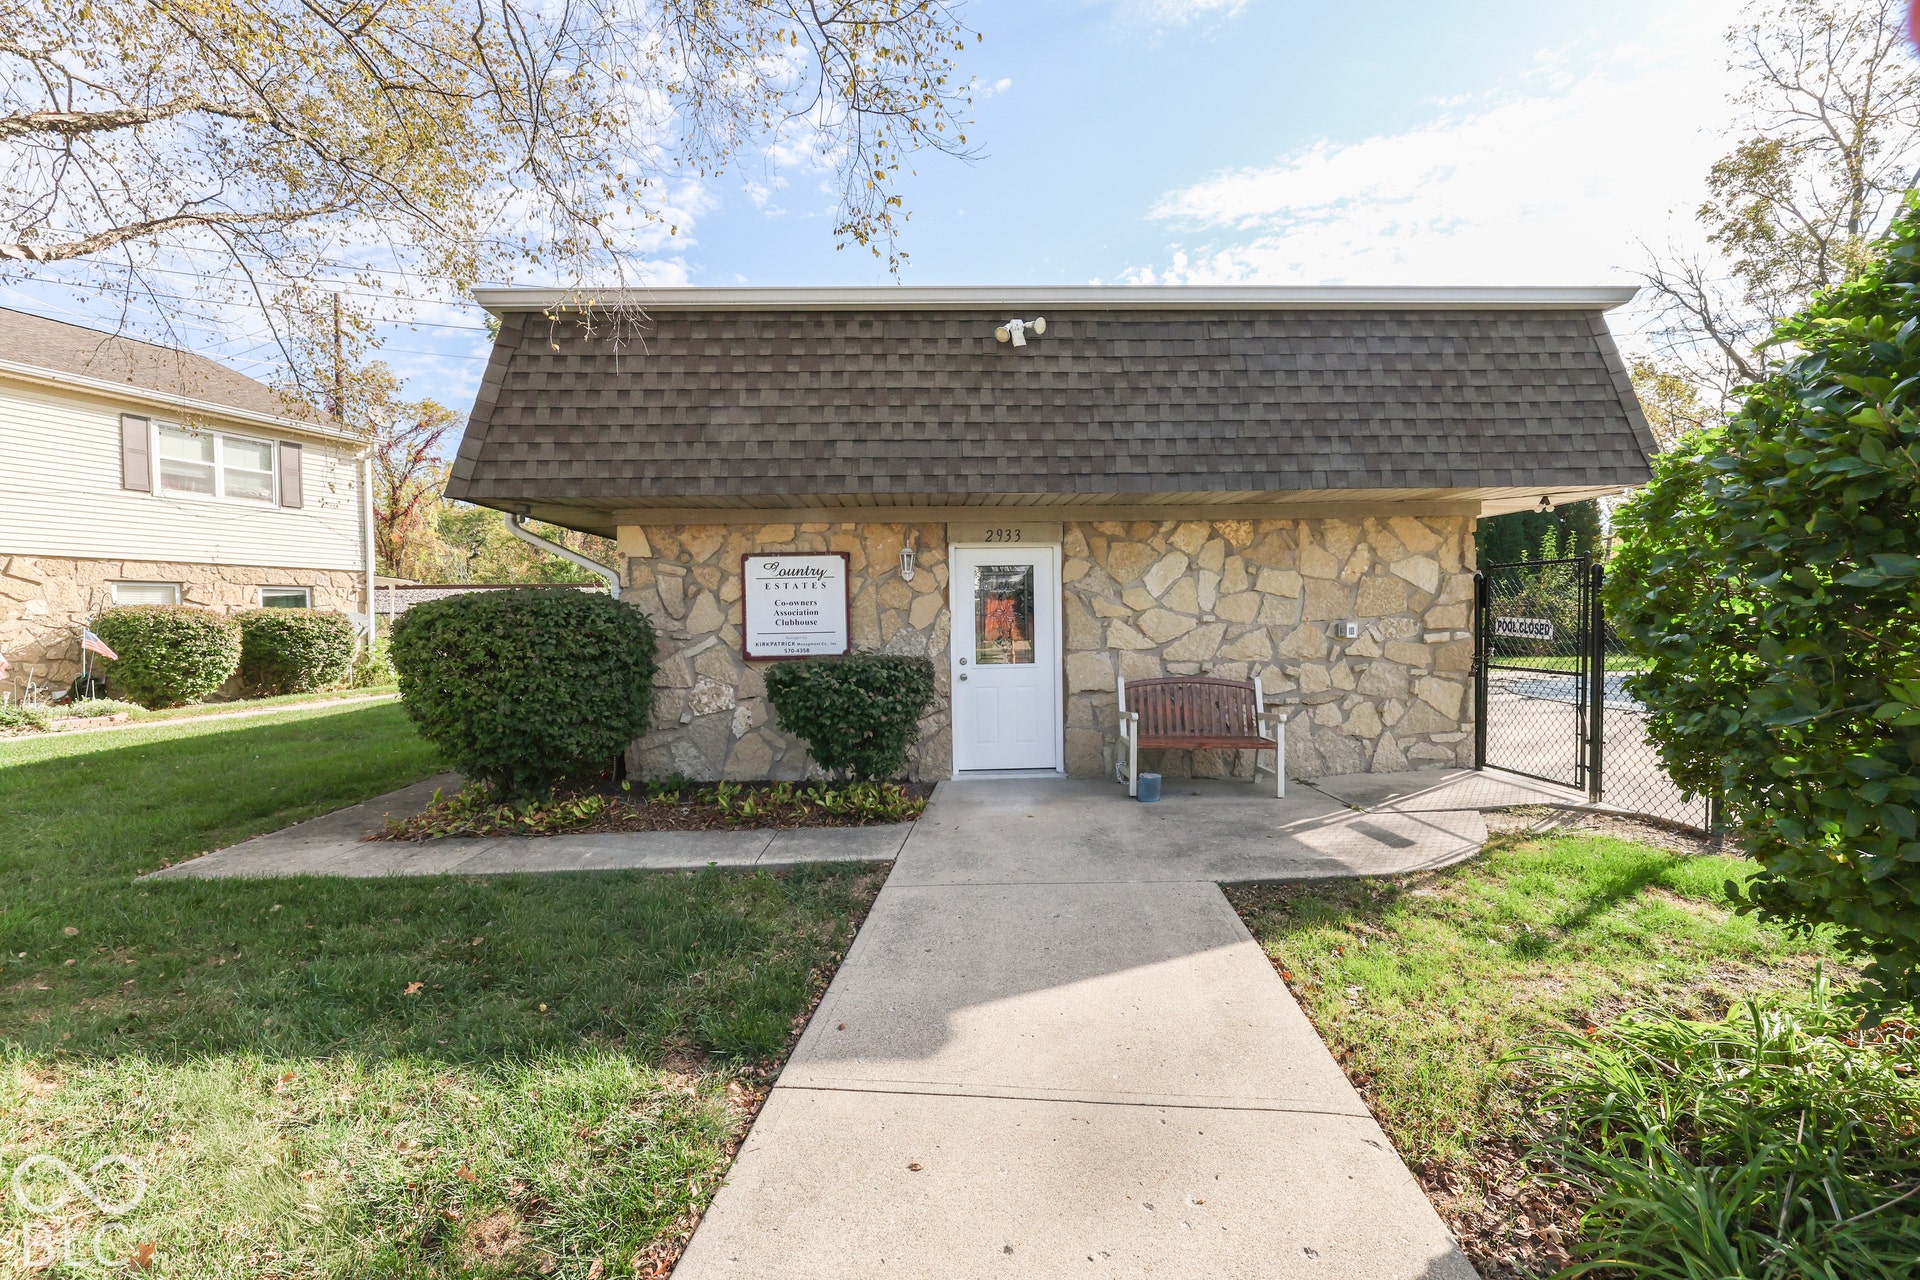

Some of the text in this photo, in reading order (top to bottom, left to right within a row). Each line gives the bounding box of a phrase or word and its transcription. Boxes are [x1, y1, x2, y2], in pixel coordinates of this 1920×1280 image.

[985, 529, 1021, 542] 2933
[763, 561, 827, 581] Country
[765, 582, 827, 590] ESTATES
[1497, 620, 1550, 635] POOL CLOSED
